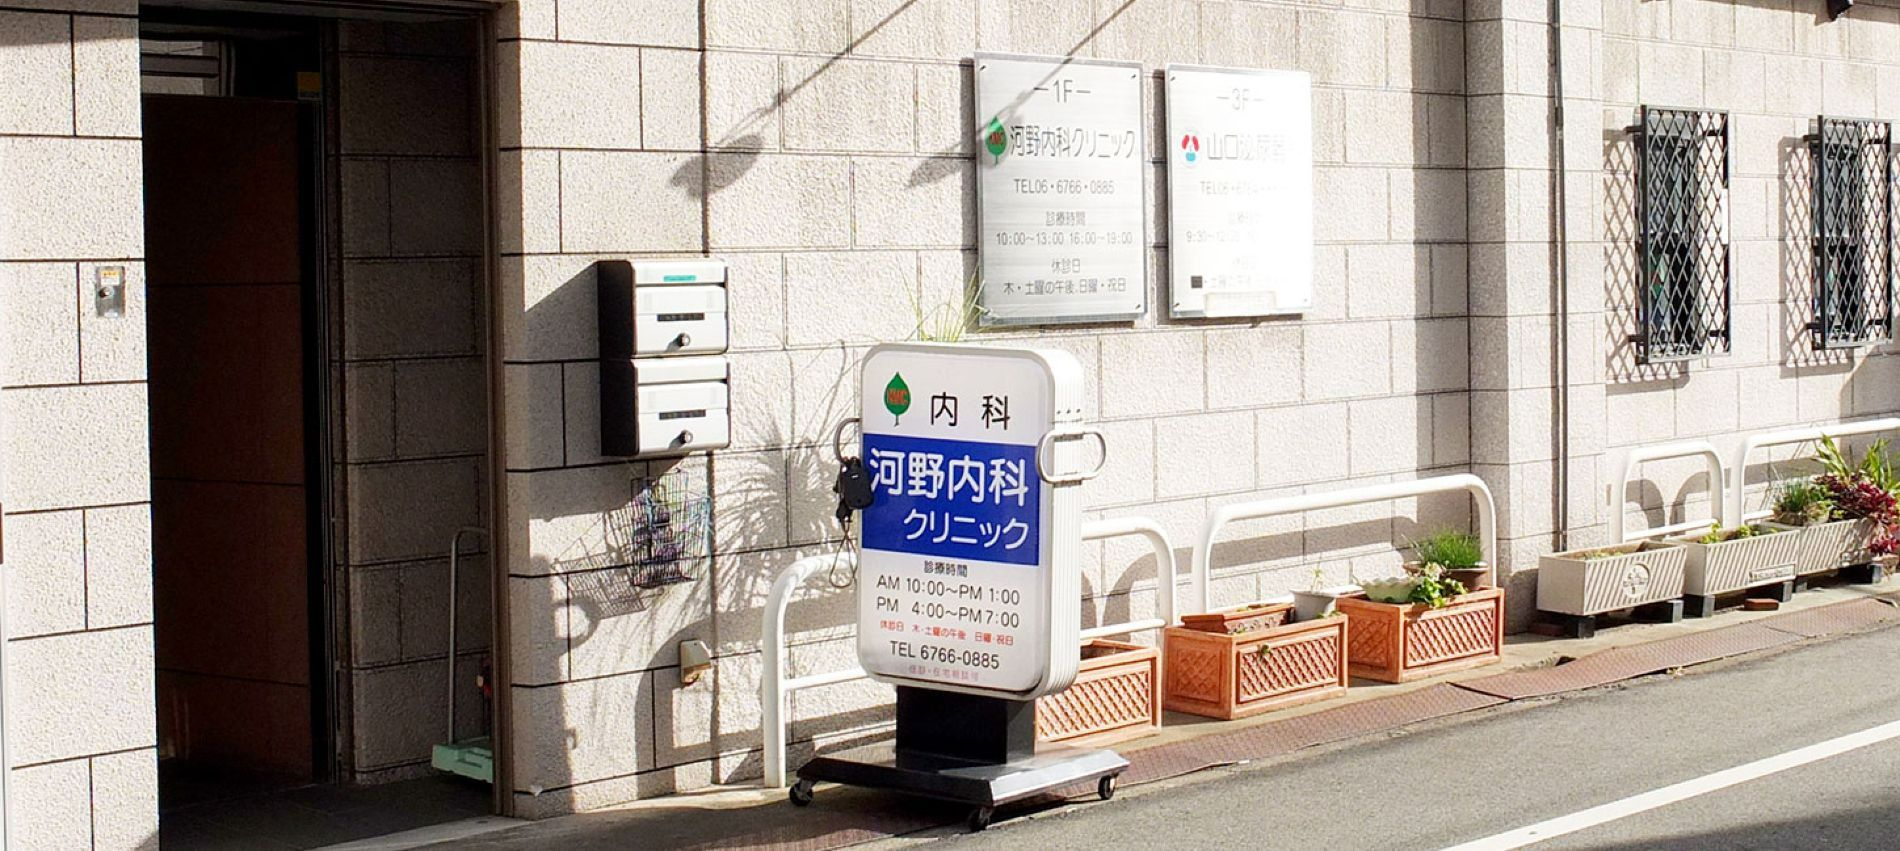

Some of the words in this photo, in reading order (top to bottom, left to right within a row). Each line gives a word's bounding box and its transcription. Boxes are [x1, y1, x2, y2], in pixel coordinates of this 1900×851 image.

[1010, 125, 1136, 158] 河野内科クリニック
[1046, 211, 1086, 226] 診療時間
[1051, 258, 1081, 274] 休診日
[870, 447, 1029, 507] 河野内科
[904, 508, 1029, 549] クリニック
[924, 560, 968, 577] 診療時間
[876, 574, 900, 591] AM
[989, 588, 1021, 606] 1:00
[876, 596, 899, 613] PM
[880, 620, 905, 632] 休診日
[890, 641, 916, 658] TEL
[920, 644, 1000, 670] 6766-0885
